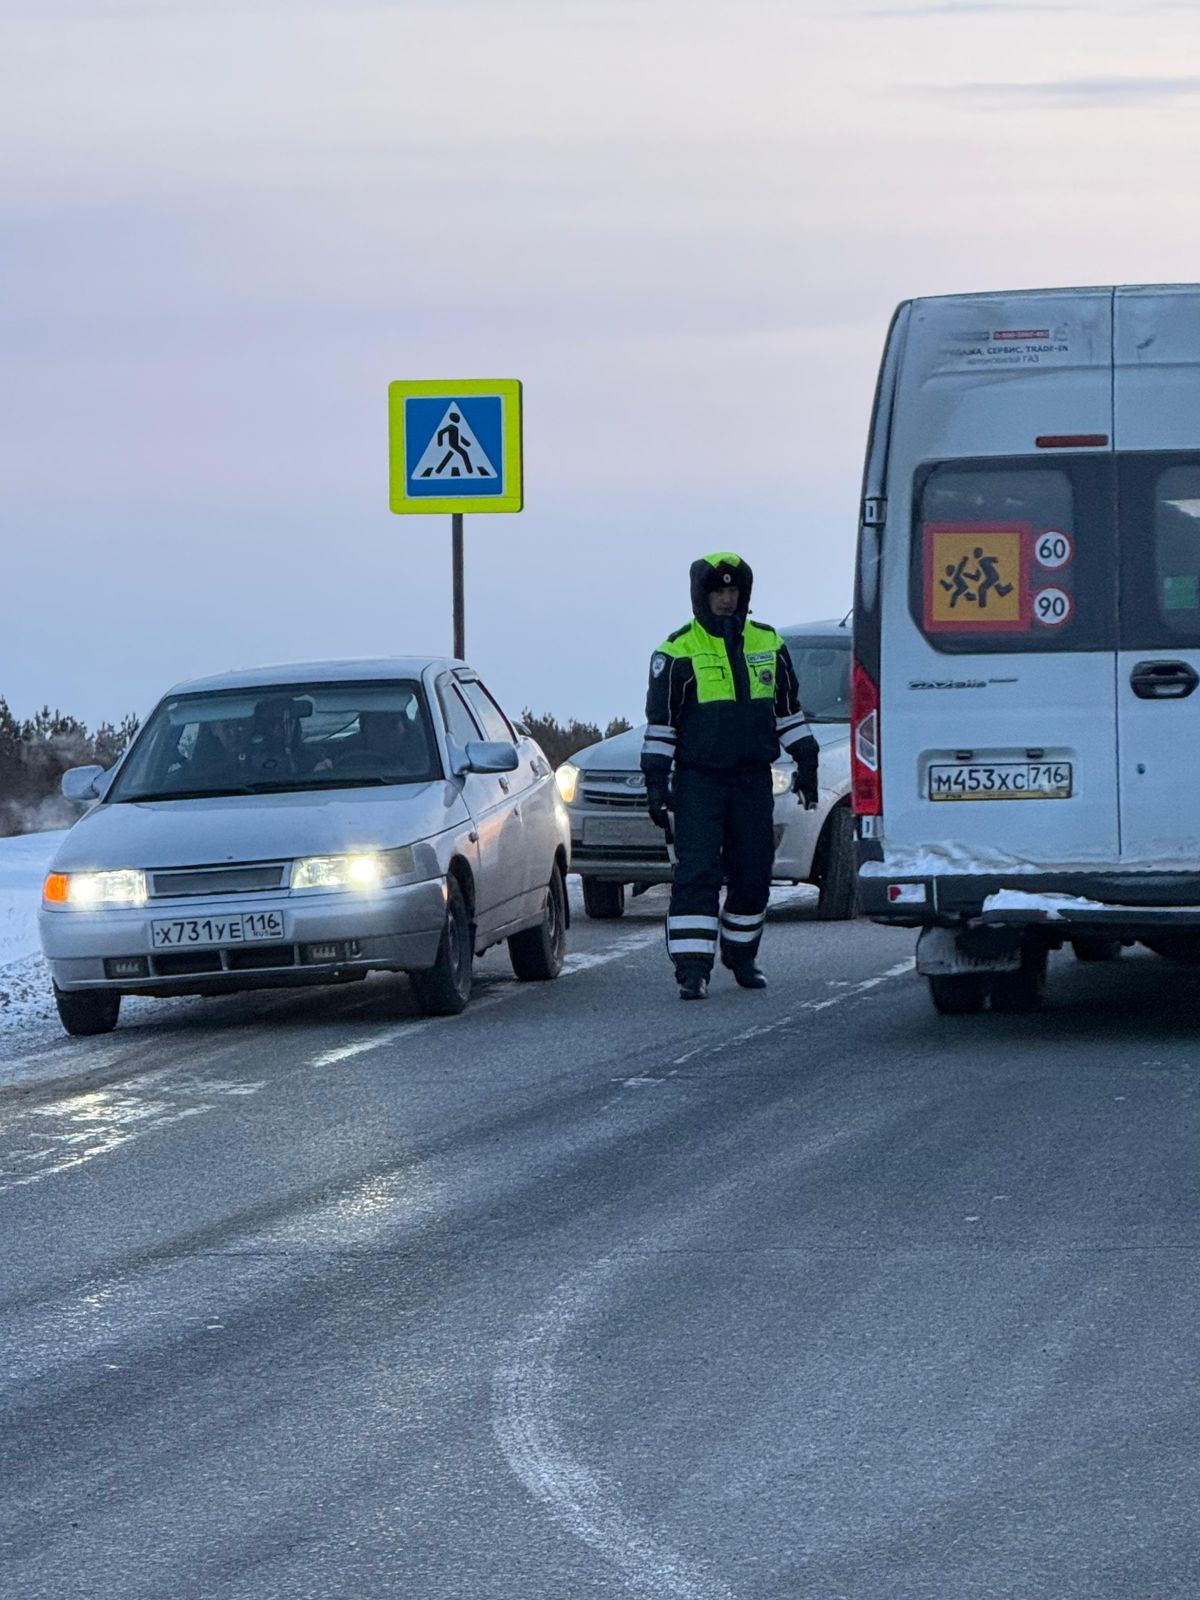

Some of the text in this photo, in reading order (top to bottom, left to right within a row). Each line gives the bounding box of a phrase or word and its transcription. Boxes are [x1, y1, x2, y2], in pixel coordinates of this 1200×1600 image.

[1023, 354, 1039, 362] ГАЗ
[1039, 538, 1066, 559] 60
[1038, 596, 1065, 617] 90
